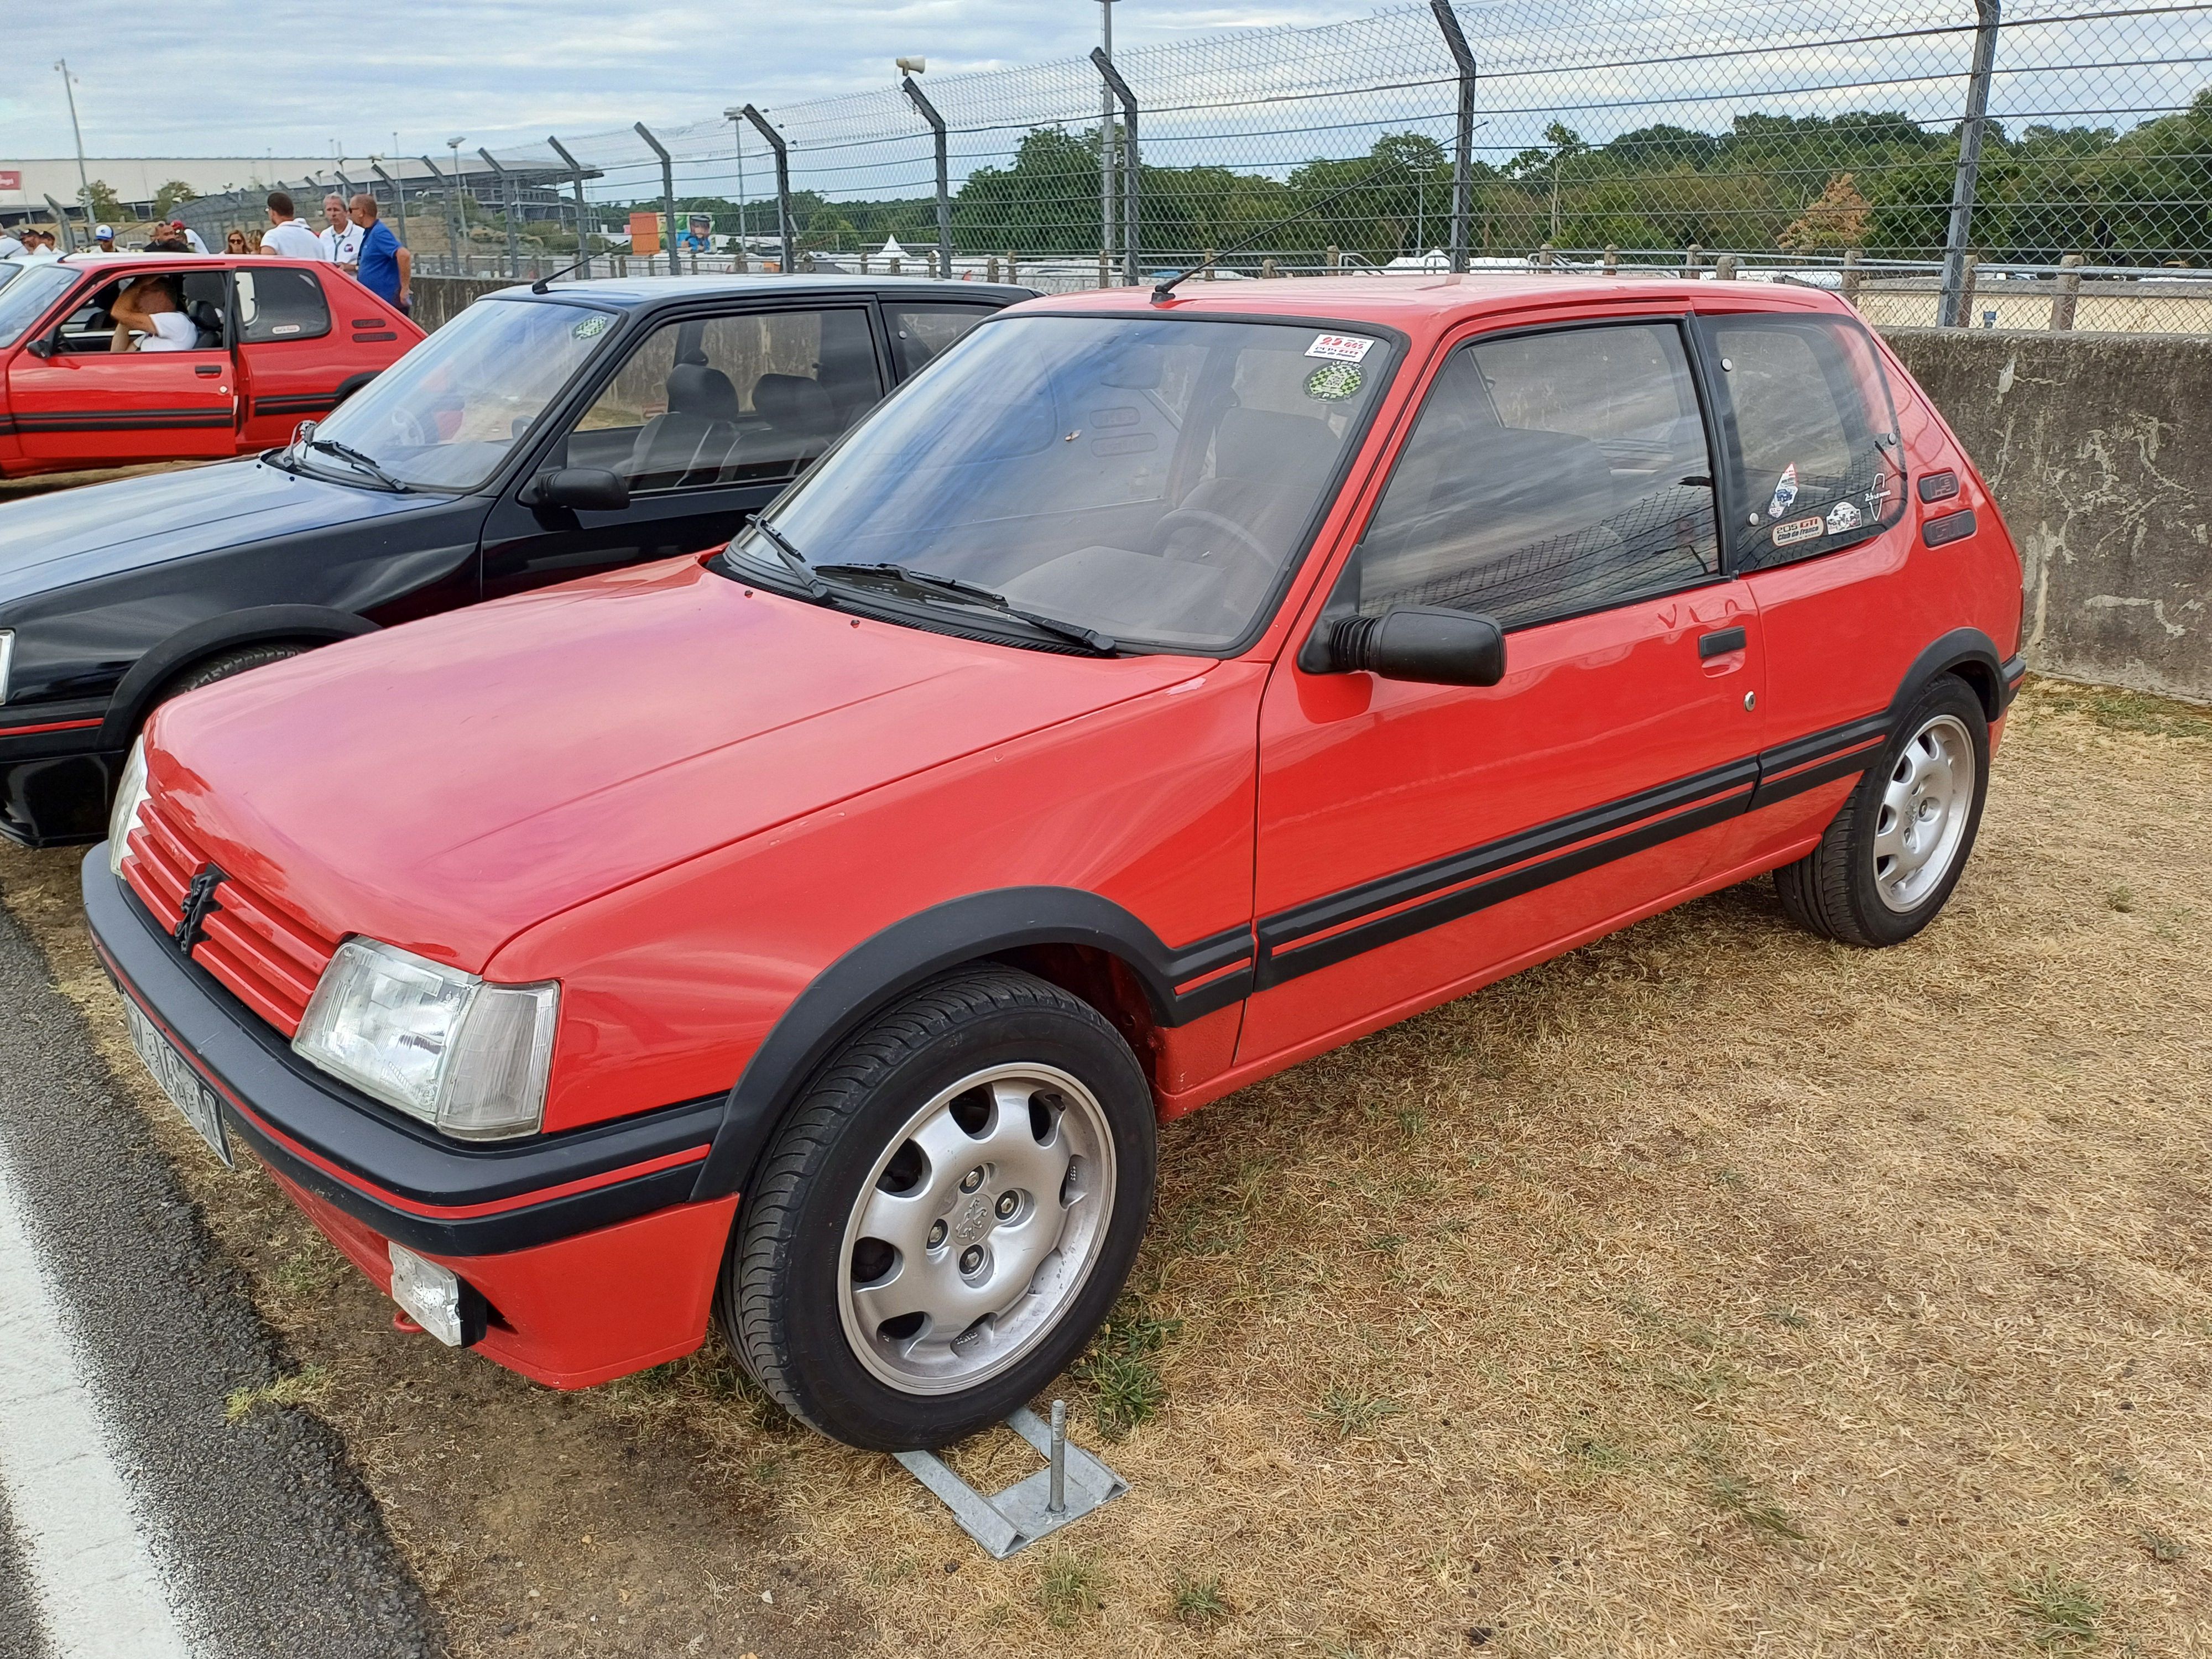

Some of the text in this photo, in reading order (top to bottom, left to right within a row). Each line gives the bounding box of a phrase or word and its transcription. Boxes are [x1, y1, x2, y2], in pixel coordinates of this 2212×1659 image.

[1776, 518, 1818, 534] 205 GTI
[1777, 532, 1791, 541] Club
